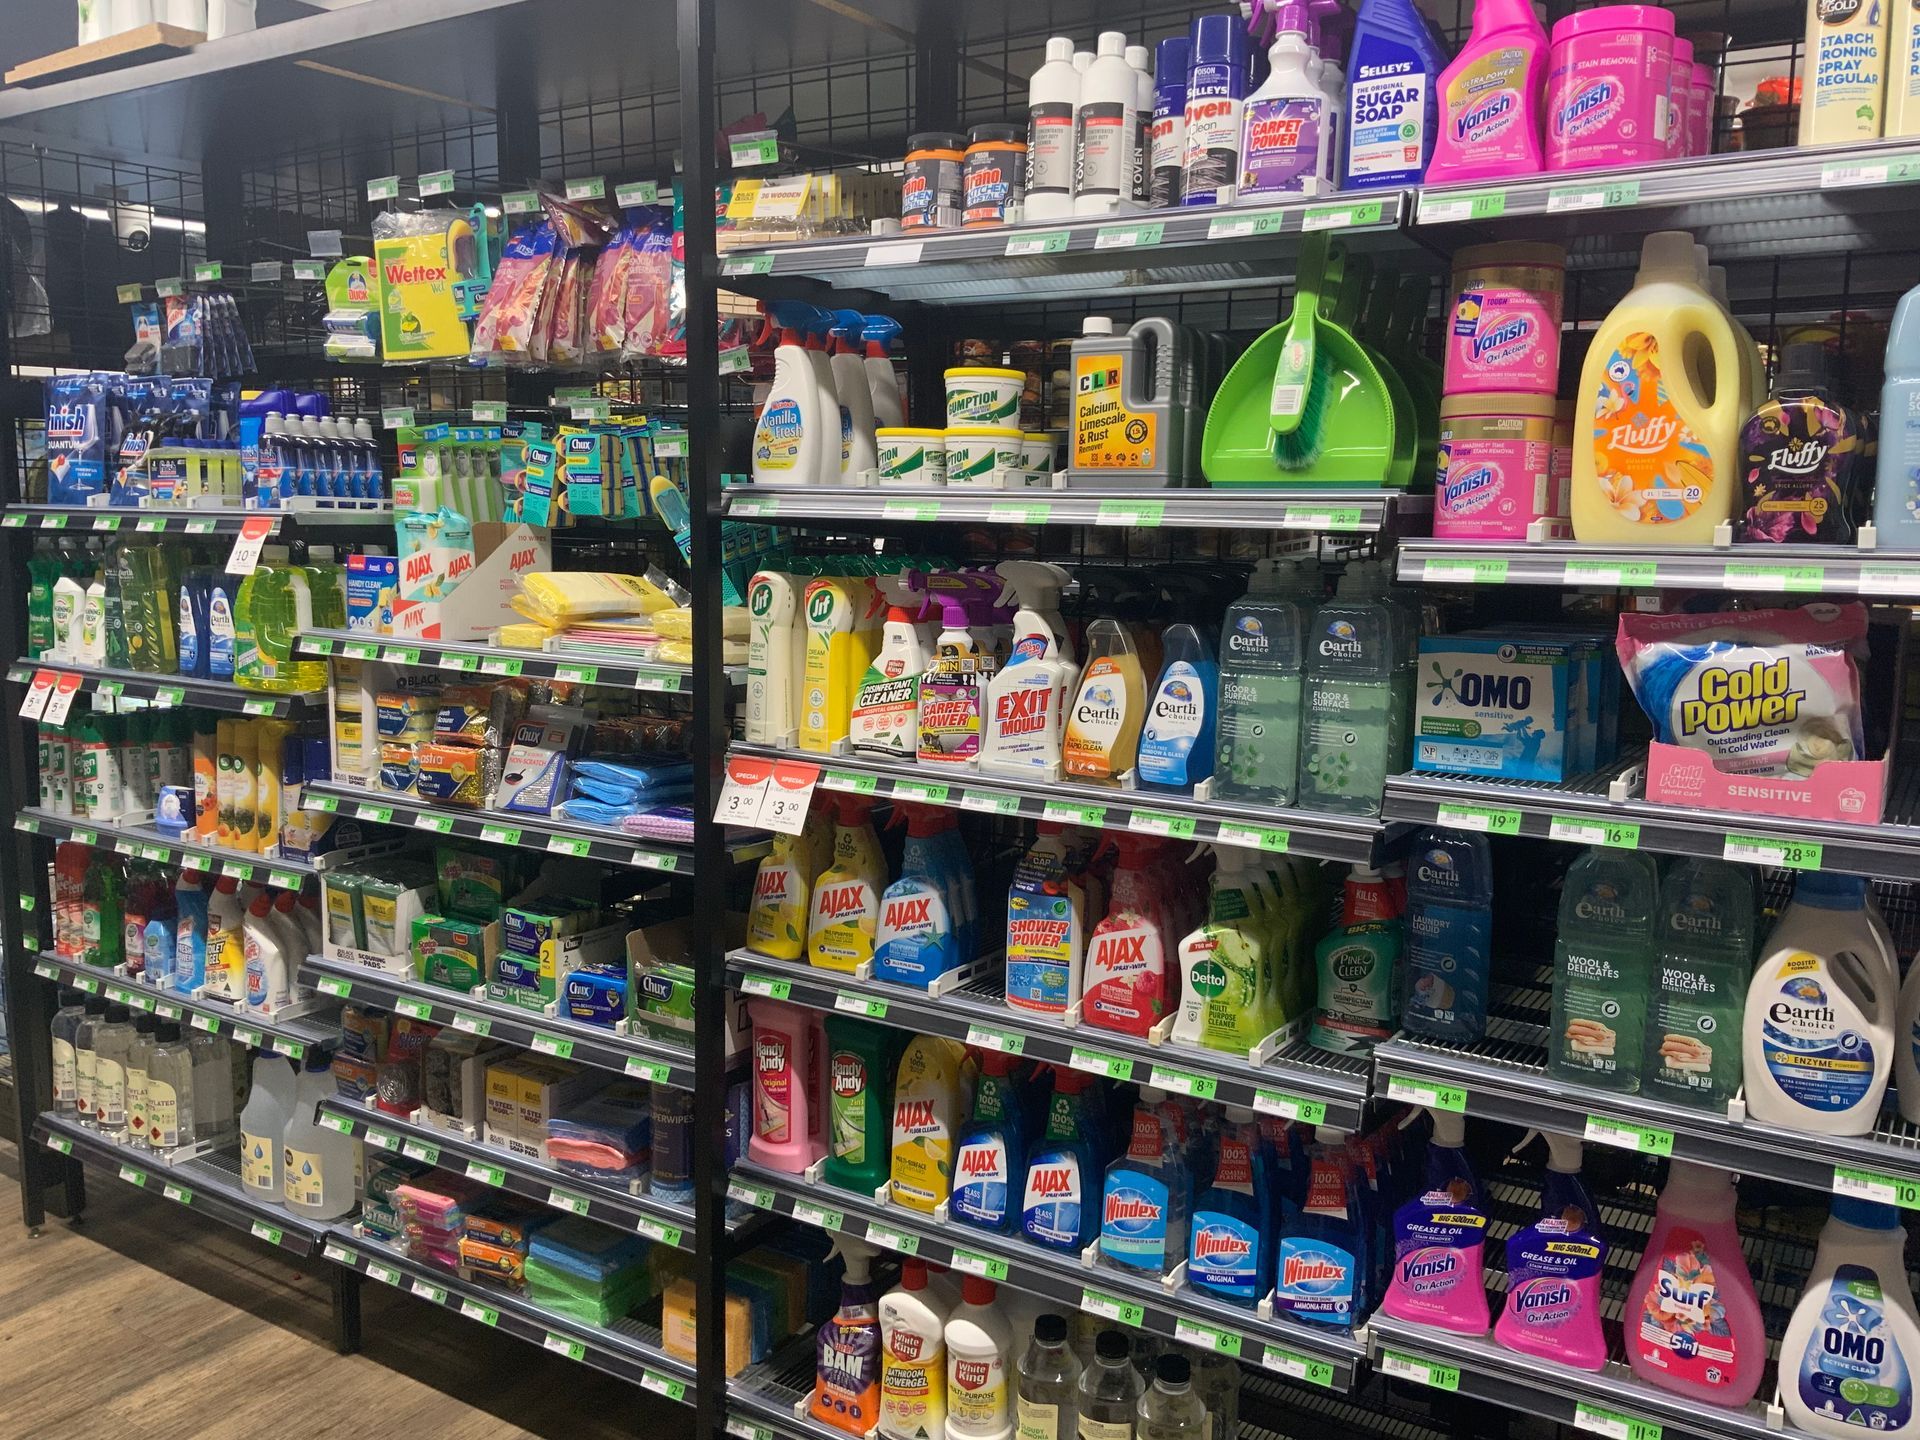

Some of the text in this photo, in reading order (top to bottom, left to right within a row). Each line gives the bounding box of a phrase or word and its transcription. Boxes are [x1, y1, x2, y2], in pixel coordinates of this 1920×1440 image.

[1828, 1, 1858, 12] GOLD
[1821, 33, 1874, 48] STARCH
[1360, 63, 1410, 78] SELLEYS
[1577, 57, 1638, 70] STAIN REMOVAL
[1819, 60, 1862, 74] SPRAY
[1461, 68, 1516, 88] ULTRA POWER
[1816, 73, 1878, 87] REGULAR
[1372, 82, 1404, 91] ORIGINAL
[1355, 89, 1419, 110] SUGAR
[1558, 80, 1611, 133] Vanish
[1185, 101, 1231, 127] Oven
[1355, 105, 1403, 124] SOAP
[1457, 96, 1511, 134] Vanish
[1191, 121, 1217, 134] Clean
[1252, 119, 1303, 137] CARPET
[1252, 134, 1298, 149] POWER
[771, 191, 802, 199] WOODEN
[386, 264, 446, 284] Wettex
[348, 289, 369, 300] DUCK
[1472, 319, 1527, 362] Vanish
[1080, 369, 1120, 392] CLR
[948, 390, 998, 416] GUMPTION
[1080, 401, 1121, 418] Calcium,
[763, 413, 797, 428] Vanilla
[1079, 412, 1126, 431] Limescale
[775, 426, 802, 439] Fresh
[1079, 428, 1109, 444] & Rust
[1611, 416, 1677, 450] Fluffy
[571, 439, 591, 450] Chux
[1078, 443, 1104, 454] Remover
[531, 450, 550, 464] Chux
[1769, 441, 1827, 471] Fluffy
[1687, 488, 1700, 498] 20
[1813, 500, 1825, 510] 25
[529, 534, 546, 542] WIPES
[448, 553, 472, 578] AJAX
[510, 548, 536, 572] AJAX
[406, 554, 433, 583] AJAX
[1229, 635, 1268, 651] earth
[1319, 640, 1362, 656] earth
[408, 674, 441, 685] BLACK
[864, 679, 913, 694] DISINFECTANT
[1702, 657, 1789, 702] Cold
[1225, 685, 1248, 694] FLOOR
[1225, 692, 1257, 702] SURFACE
[1461, 673, 1531, 710] OMO
[860, 688, 912, 707] CLEANER
[996, 688, 1052, 722] EXIT
[923, 700, 972, 716] CARPET
[1078, 706, 1119, 723] earth
[1156, 702, 1196, 717] earth
[1475, 711, 1513, 720] sensitive
[1682, 690, 1806, 736] Power
[1000, 716, 1046, 738] MOULD
[1091, 718, 1118, 726] choice
[518, 727, 540, 743] Chux
[1707, 727, 1790, 747] Outstanding Clean
[1728, 741, 1750, 753] Cold
[1752, 738, 1778, 749] Water
[736, 772, 759, 781] SPECIAL
[781, 777, 805, 785] SPECIAL
[1727, 785, 1812, 803] SENSITIVE
[728, 796, 753, 810] $3.00
[773, 801, 799, 815] $3.00
[1778, 846, 1816, 862] $28.50
[820, 885, 864, 918] AJAX
[1356, 891, 1377, 902] KILLS
[506, 913, 522, 928] Chux
[885, 898, 931, 931] AJAX
[1412, 914, 1450, 928] LAUNDRY
[1010, 920, 1069, 934] SHOWER
[1412, 921, 1440, 934] LIQUID
[209, 953, 221, 964] GEL
[359, 953, 386, 963] SCOURING
[542, 950, 550, 963] 2
[1096, 936, 1146, 972] AJAX
[1340, 954, 1362, 965] PINE
[1568, 954, 1610, 968] WOOL &
[364, 960, 380, 969] PADS
[500, 961, 519, 977] Chux
[1339, 964, 1367, 978] CLEEN
[1567, 963, 1619, 979] DELICATES
[1191, 970, 1225, 987] Dettol
[490, 985, 506, 997] Chux
[569, 982, 590, 997] Chux
[643, 977, 668, 997] Chux
[1209, 1004, 1228, 1013] MULTI
[1769, 1002, 1835, 1024] earth
[1208, 1012, 1236, 1021] PURPOSE
[1208, 1019, 1236, 1029] CLEANER
[1792, 1018, 1834, 1031] choice
[756, 1041, 786, 1057] Handy
[759, 1054, 787, 1071] Andy
[832, 1061, 862, 1078] Handy
[1794, 1058, 1832, 1067] ENZYME
[763, 1078, 787, 1087] Original
[834, 1077, 862, 1093] Andy
[1438, 1092, 1462, 1104] $4.08
[896, 1100, 937, 1134] AJAX
[1301, 1105, 1321, 1118] $8.78
[510, 1140, 538, 1153] STEEL WOOL
[1644, 1134, 1669, 1148] $3.44
[510, 1145, 539, 1158] SOAP PADS
[1223, 1149, 1247, 1160] 100%
[962, 1149, 998, 1174] AJAX
[1032, 1169, 1071, 1194] AJAX
[1105, 1195, 1161, 1224] Windex
[1407, 1224, 1463, 1236] GREASE & OIL
[1195, 1230, 1252, 1258] Windex
[1284, 1257, 1347, 1286] Windex
[1403, 1251, 1456, 1282] Vanish
[1207, 1275, 1235, 1284] ORIGINAL
[1516, 1283, 1571, 1313] Vanish
[1659, 1278, 1711, 1310] Surf
[1294, 1301, 1333, 1311] AMMONIA-FREE
[895, 1333, 920, 1346] White
[1824, 1327, 1884, 1365] OMO
[895, 1342, 918, 1357] King
[823, 1343, 864, 1379] BAM
[958, 1361, 986, 1373] White
[1823, 1357, 1876, 1376] ACTIVE CLEAN
[887, 1368, 925, 1378] BATHROOM
[959, 1371, 985, 1384] King
[1433, 1370, 1455, 1383] $11.54
[884, 1376, 928, 1387] POWERGEL
[1633, 1425, 1657, 1439] $11.42
